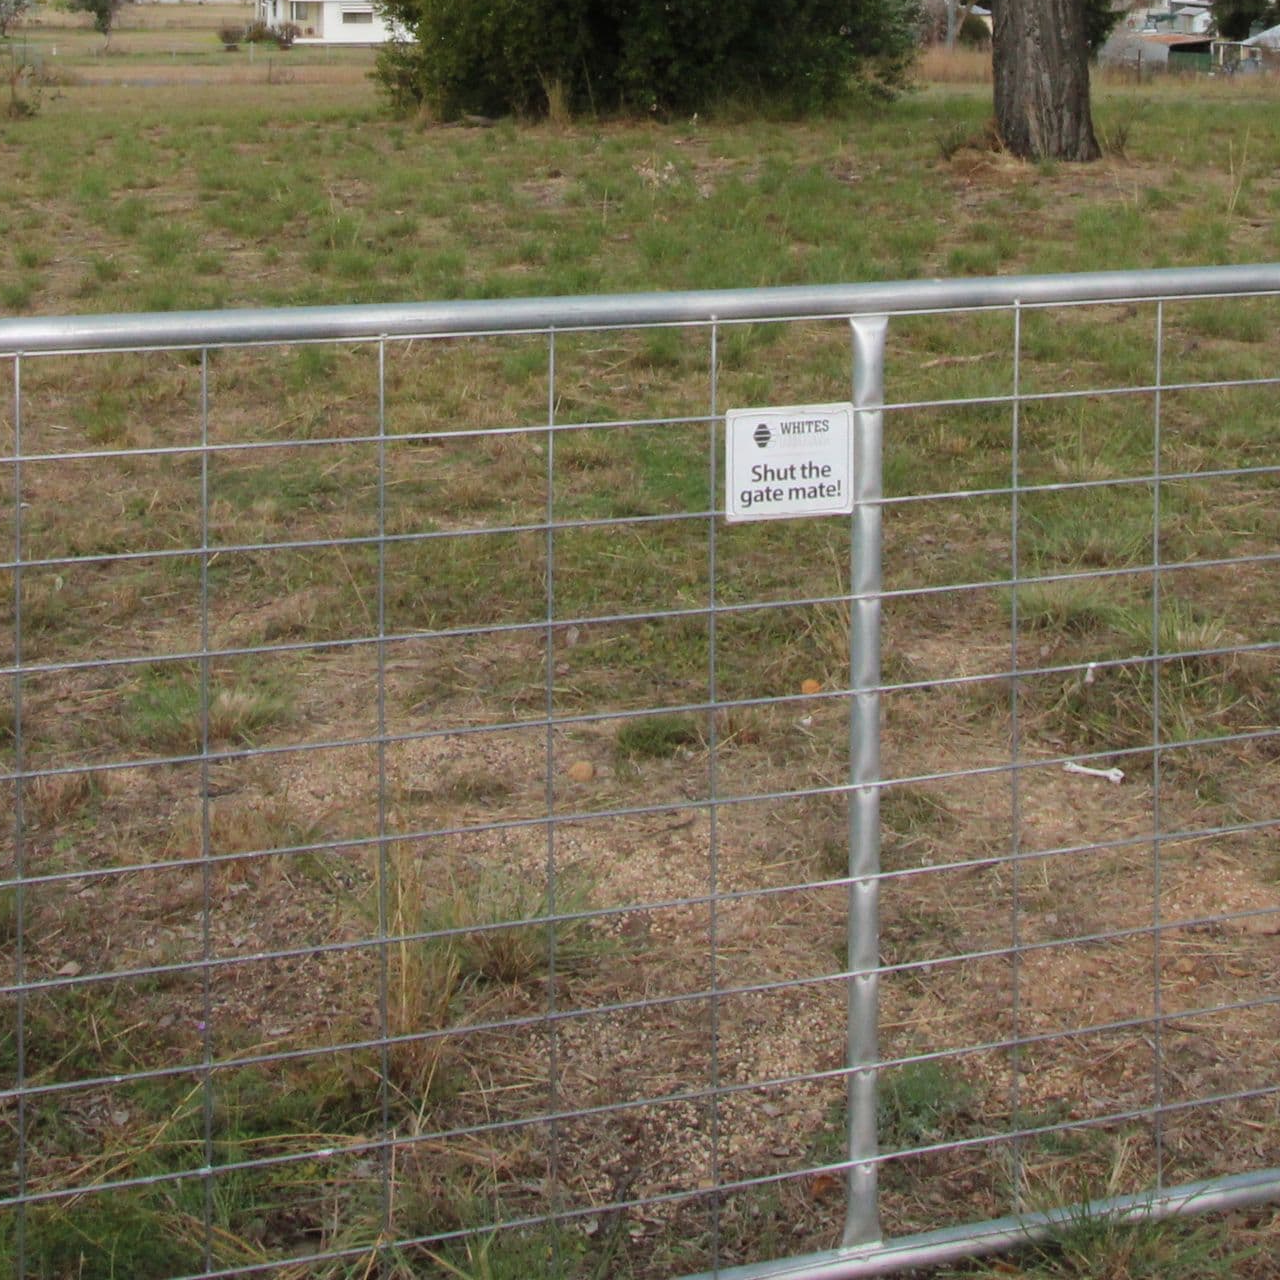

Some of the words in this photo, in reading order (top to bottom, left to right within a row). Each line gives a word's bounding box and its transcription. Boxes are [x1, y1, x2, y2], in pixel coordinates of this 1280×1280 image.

[780, 420, 829, 434] WHITES
[751, 463, 796, 483] Shut
[801, 461, 832, 480] the
[740, 485, 784, 508] gate
[788, 480, 842, 501] mate!
